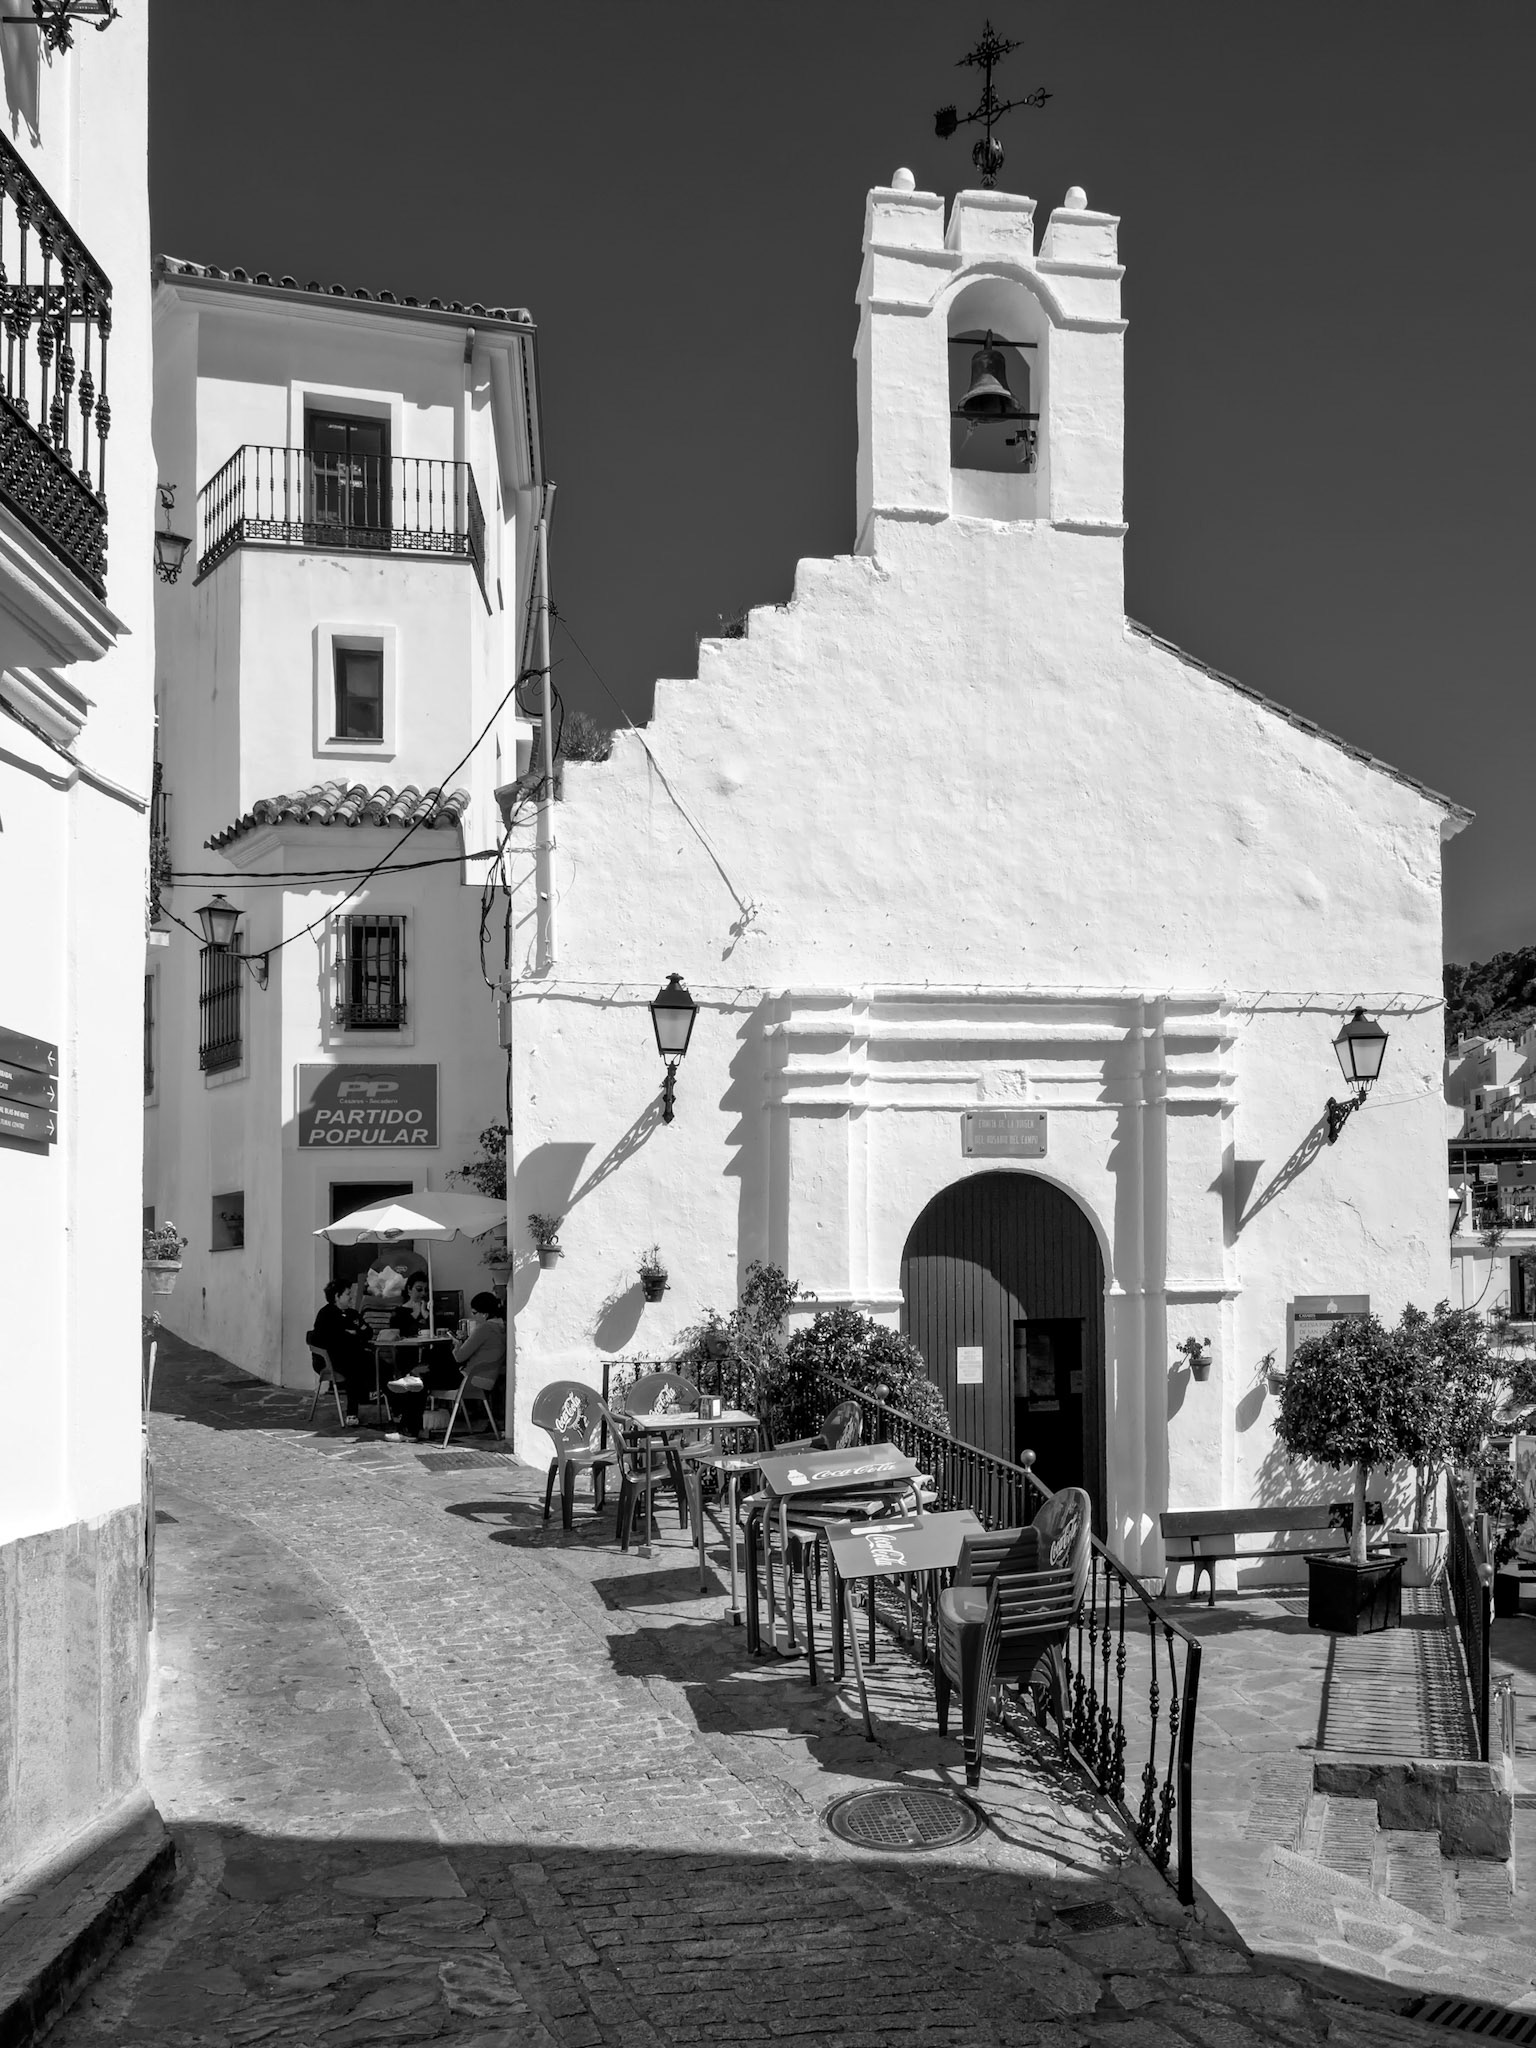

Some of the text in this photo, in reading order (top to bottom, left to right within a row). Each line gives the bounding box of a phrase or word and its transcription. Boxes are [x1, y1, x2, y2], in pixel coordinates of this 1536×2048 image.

[337, 1081, 399, 1097] PP
[314, 1109, 423, 1124] PARTIDO
[308, 1128, 429, 1144] POPULAR
